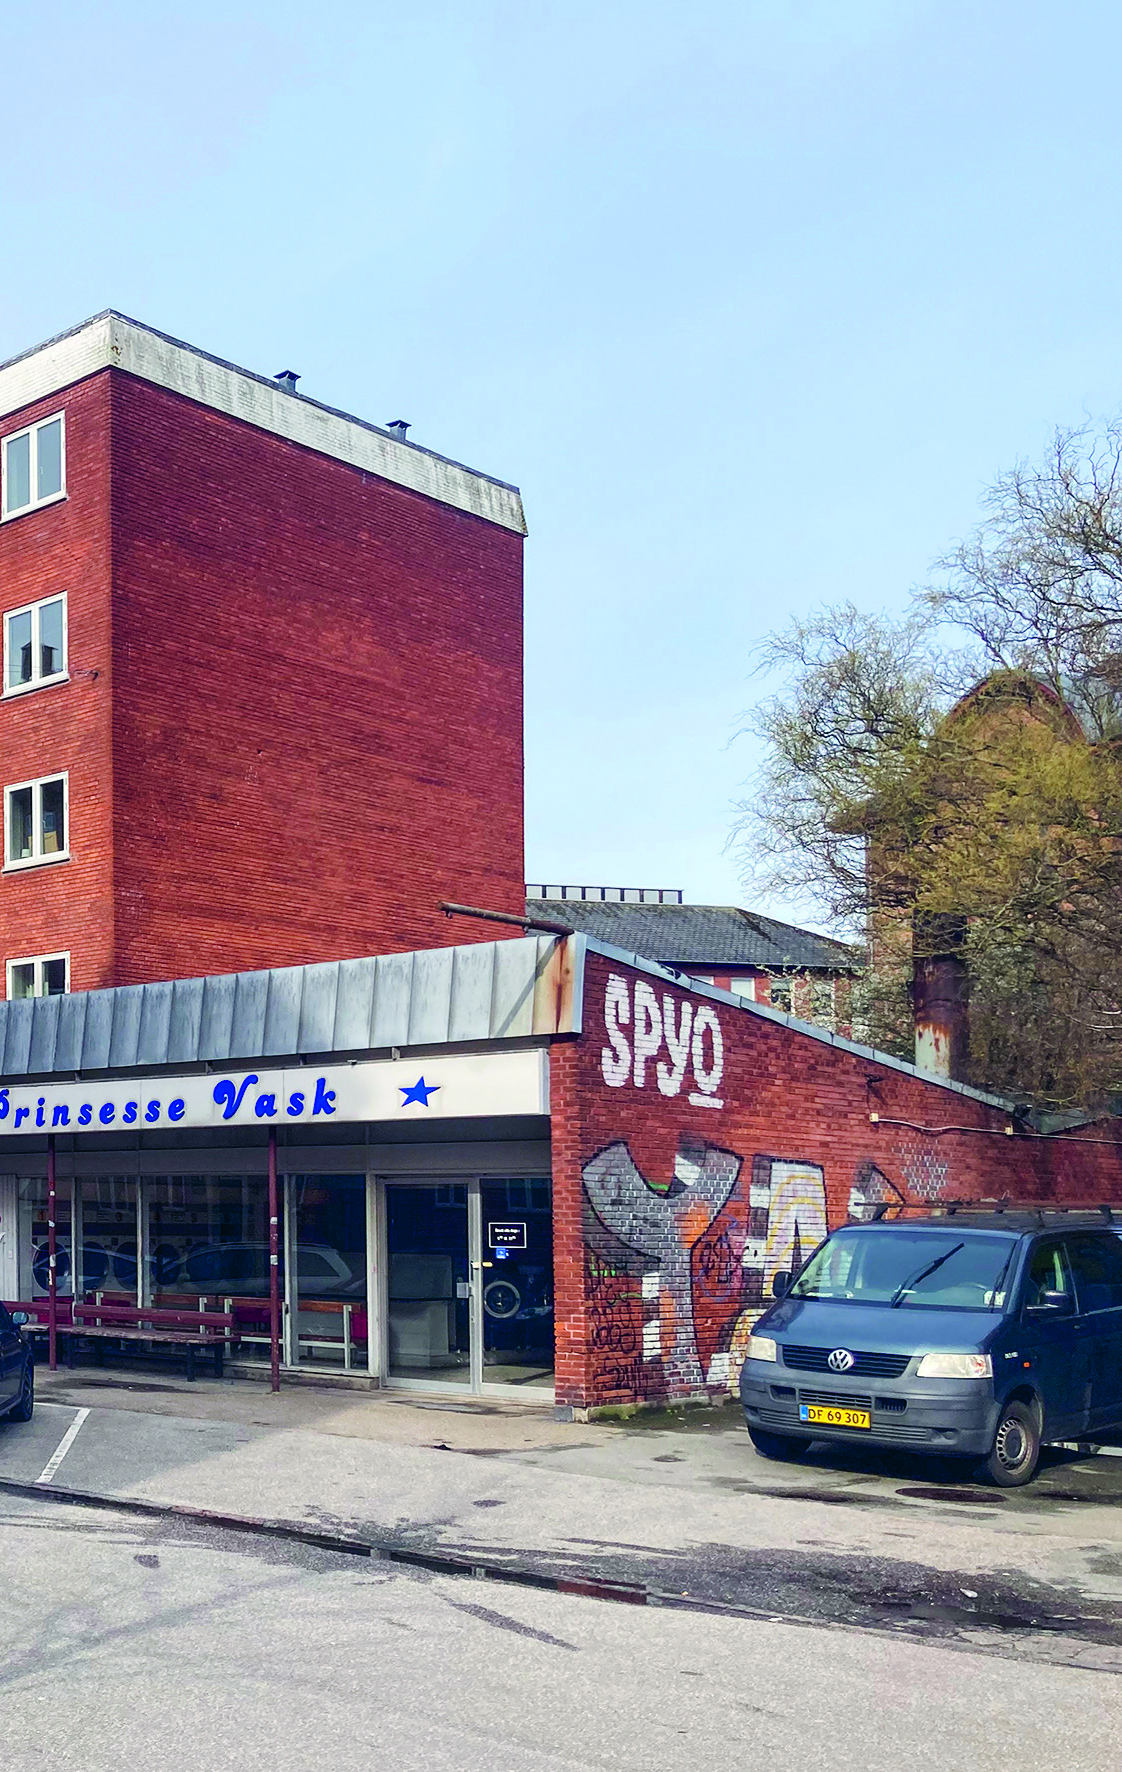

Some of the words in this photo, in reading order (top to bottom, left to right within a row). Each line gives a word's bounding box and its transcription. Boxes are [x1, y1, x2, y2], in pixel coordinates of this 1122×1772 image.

[213, 1074, 336, 1120] Vask
[808, 1408, 823, 1420] DF
[827, 1410, 842, 1422] 69
[844, 1412, 866, 1425] 307
